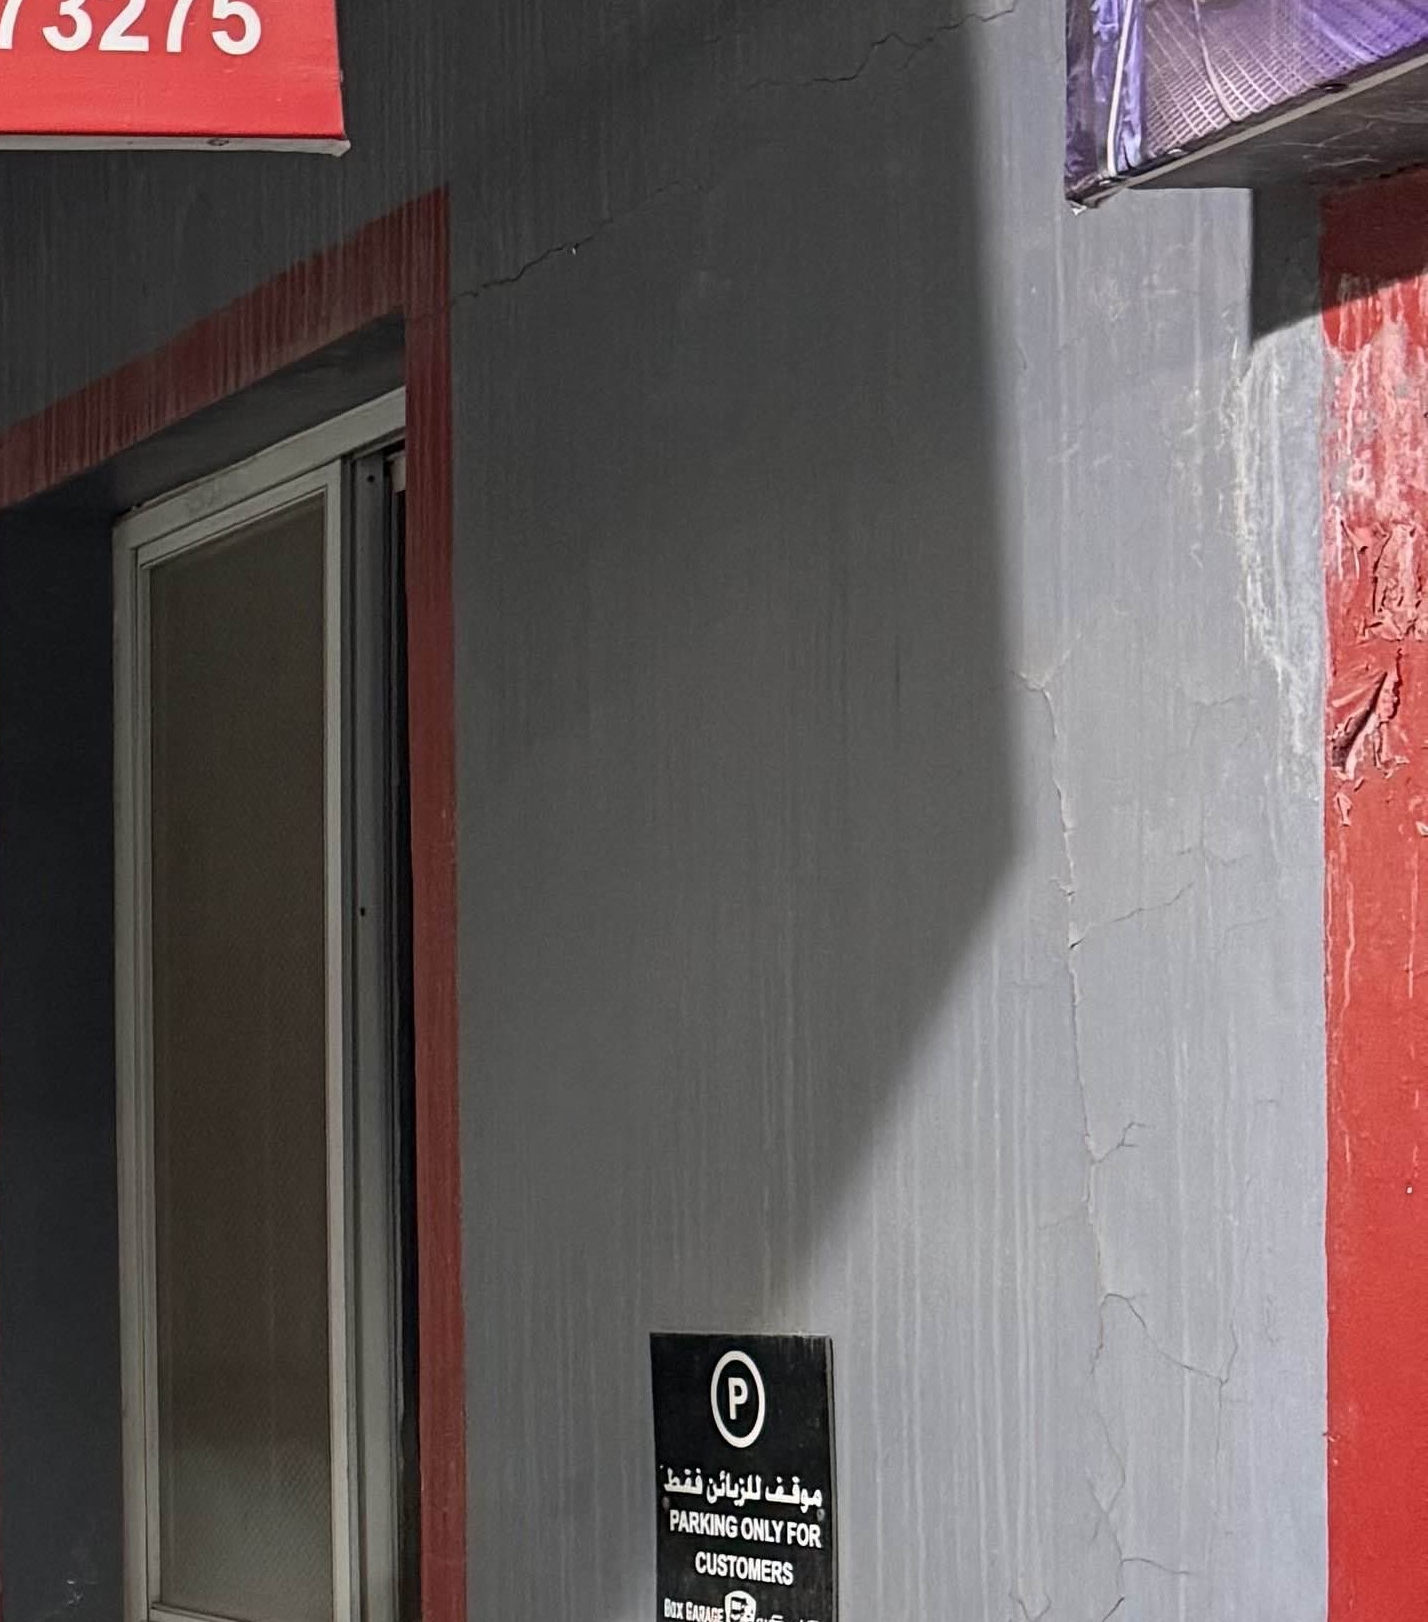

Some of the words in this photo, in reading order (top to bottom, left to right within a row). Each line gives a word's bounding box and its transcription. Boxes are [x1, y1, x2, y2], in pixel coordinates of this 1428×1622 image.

[663, 1467, 703, 1495] فقط
[706, 1470, 761, 1507] للزبائن
[765, 1475, 823, 1513] موقف
[669, 1509, 738, 1538] PARKING
[740, 1517, 784, 1543] ONLY
[786, 1521, 822, 1549] FOR
[695, 1551, 794, 1585] CUSTOMERS
